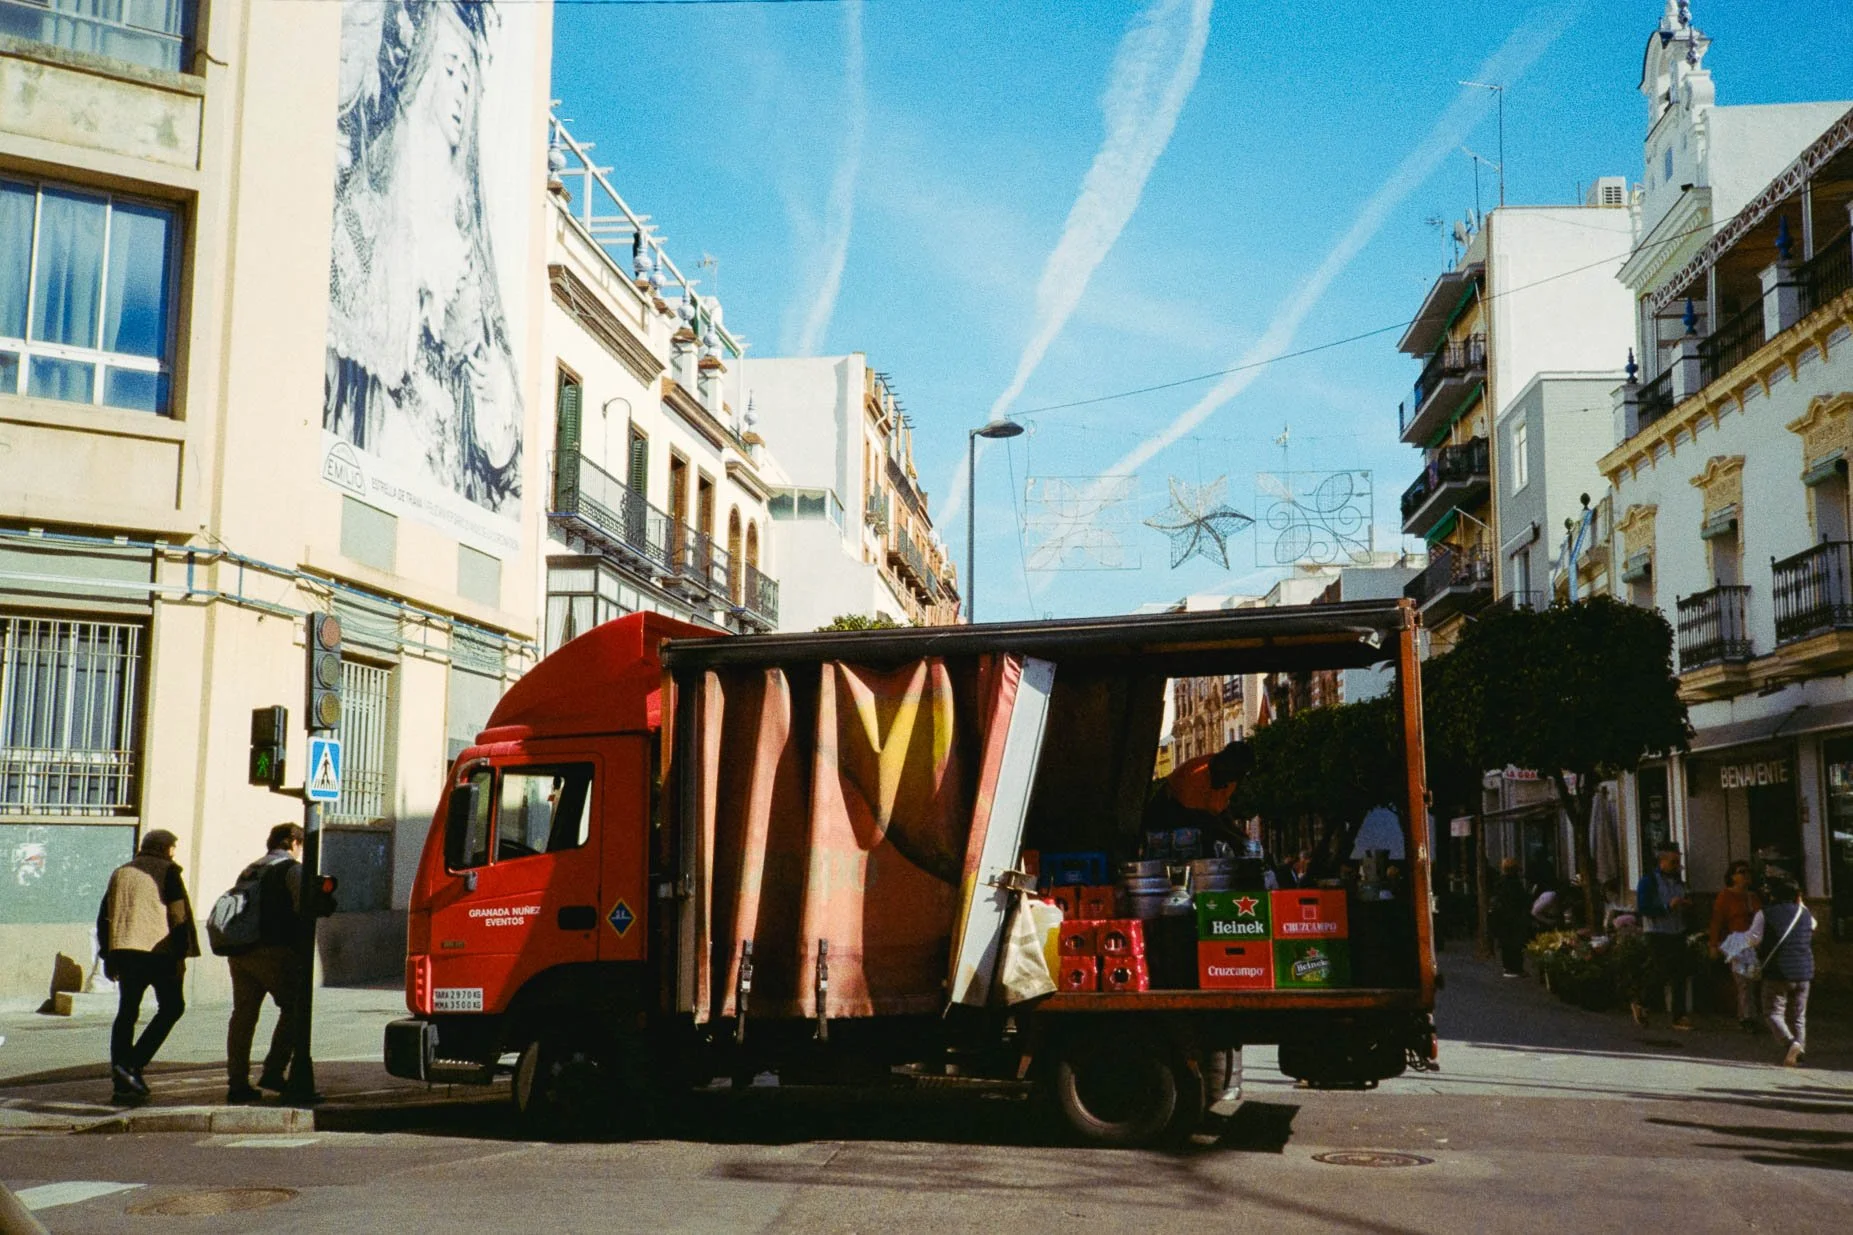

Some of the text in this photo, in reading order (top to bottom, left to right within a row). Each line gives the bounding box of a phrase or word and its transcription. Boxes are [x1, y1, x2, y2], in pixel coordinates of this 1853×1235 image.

[327, 459, 362, 488] EMILIO
[1720, 760, 1788, 788] BENAVENTE
[468, 908, 510, 918] GRANADA
[485, 917, 525, 927] EVENTOS
[1212, 920, 1264, 934] Heinek
[1282, 922, 1337, 933] CRUZCAMPO
[1208, 966, 1265, 978] Cruzcampo
[435, 990, 482, 999] TARA 2970 KG
[435, 1001, 482, 1009] MMA 3500 KG
